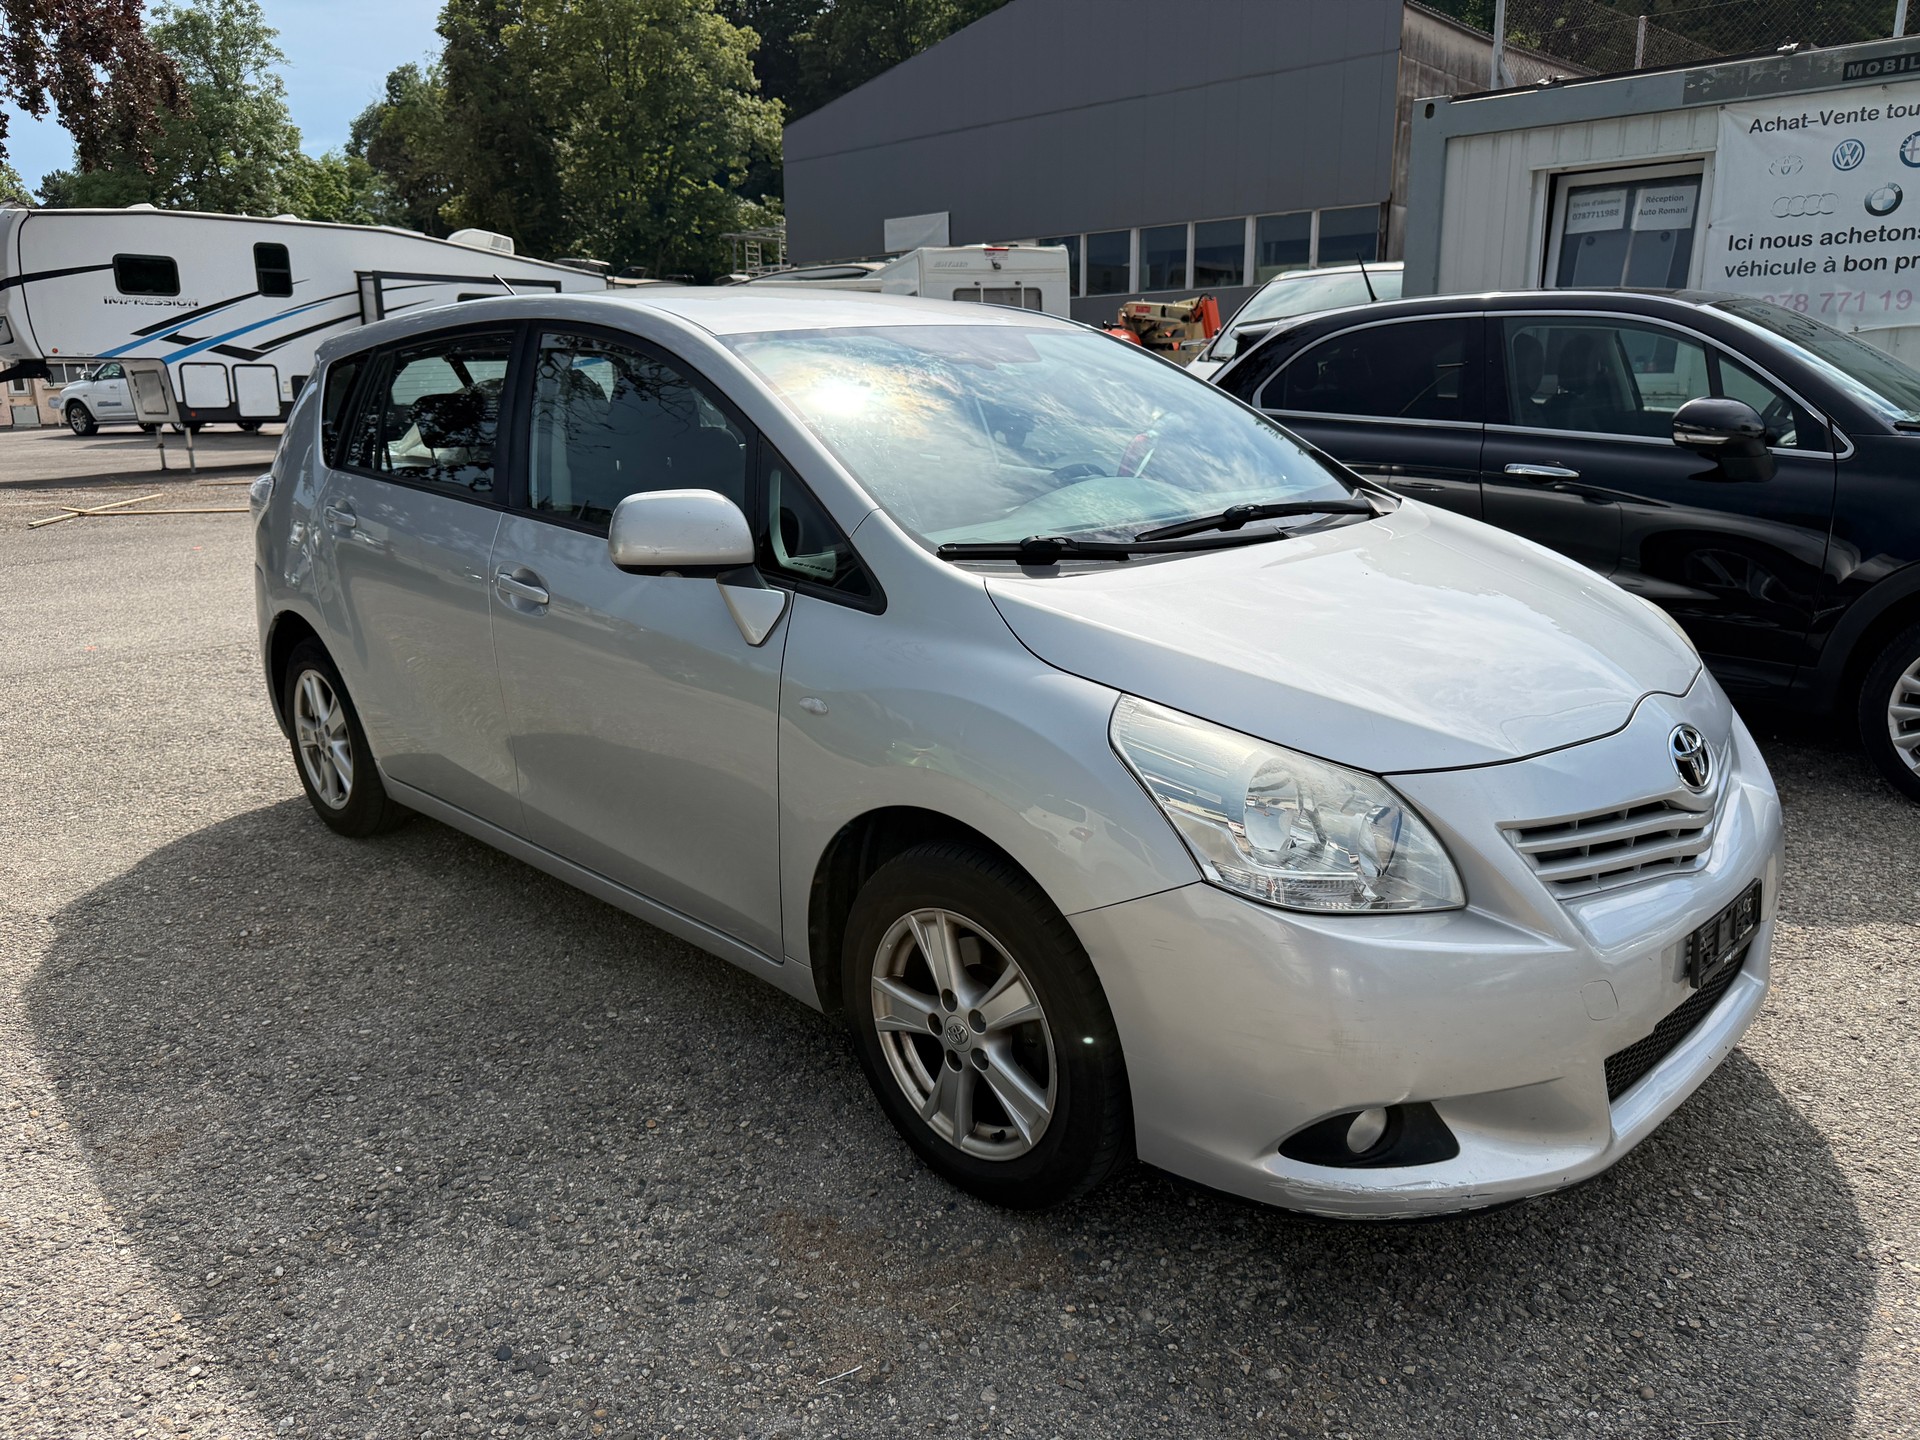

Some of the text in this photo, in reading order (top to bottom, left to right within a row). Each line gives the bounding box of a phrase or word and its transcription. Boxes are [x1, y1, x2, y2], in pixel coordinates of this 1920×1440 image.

[1847, 56, 1920, 78] MOBIL
[1645, 194, 1684, 204] Réception
[1638, 206, 1688, 217] Auto Romani
[1728, 225, 1920, 251] Ici nous acheton
[1724, 257, 1817, 278] véhicule
[1822, 256, 1836, 273] à
[1843, 255, 1888, 272] bon
[103, 296, 199, 307] IMPRESSION
[1819, 290, 1866, 314] 771
[1879, 288, 1913, 312] 19
